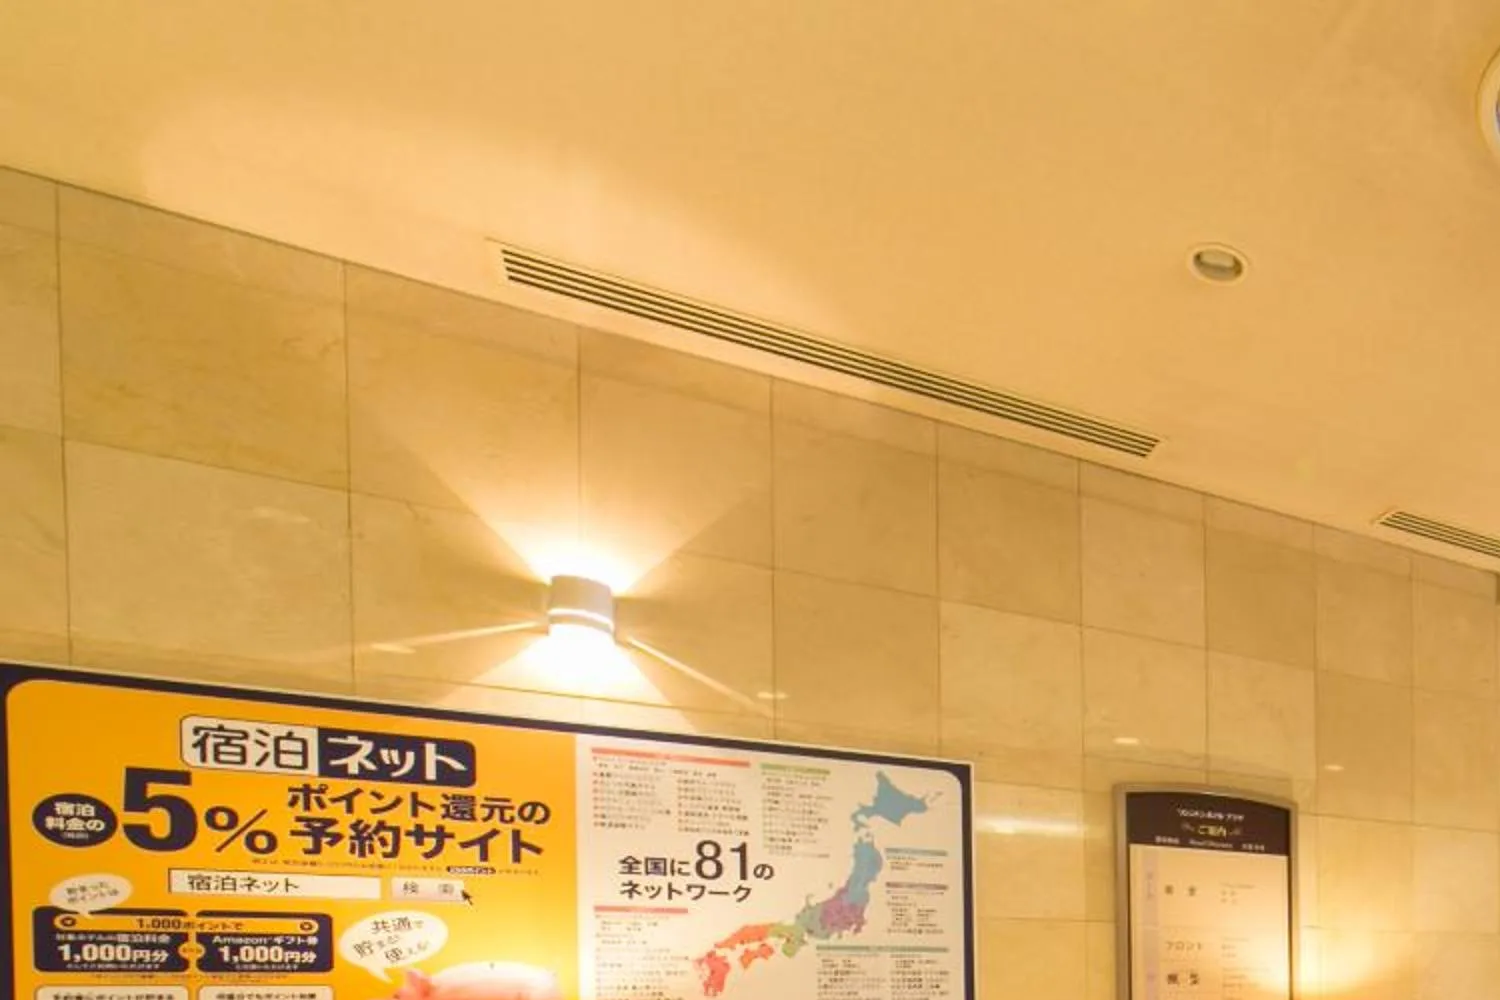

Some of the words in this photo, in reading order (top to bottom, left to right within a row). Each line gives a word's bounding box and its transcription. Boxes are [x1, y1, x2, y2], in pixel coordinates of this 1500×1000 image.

[191, 723, 468, 782] 宿泊ネット
[54, 801, 96, 817] 宿泊
[287, 783, 551, 827] ポイント還元の
[45, 817, 106, 832] 料金の
[289, 815, 545, 865] 予約サイト
[618, 839, 775, 882] 全国に81の
[187, 873, 301, 896] 宿泊ネット
[619, 880, 752, 903] ネットワーク
[57, 943, 169, 963] 1,000円分
[218, 945, 317, 964] 1,000円分
